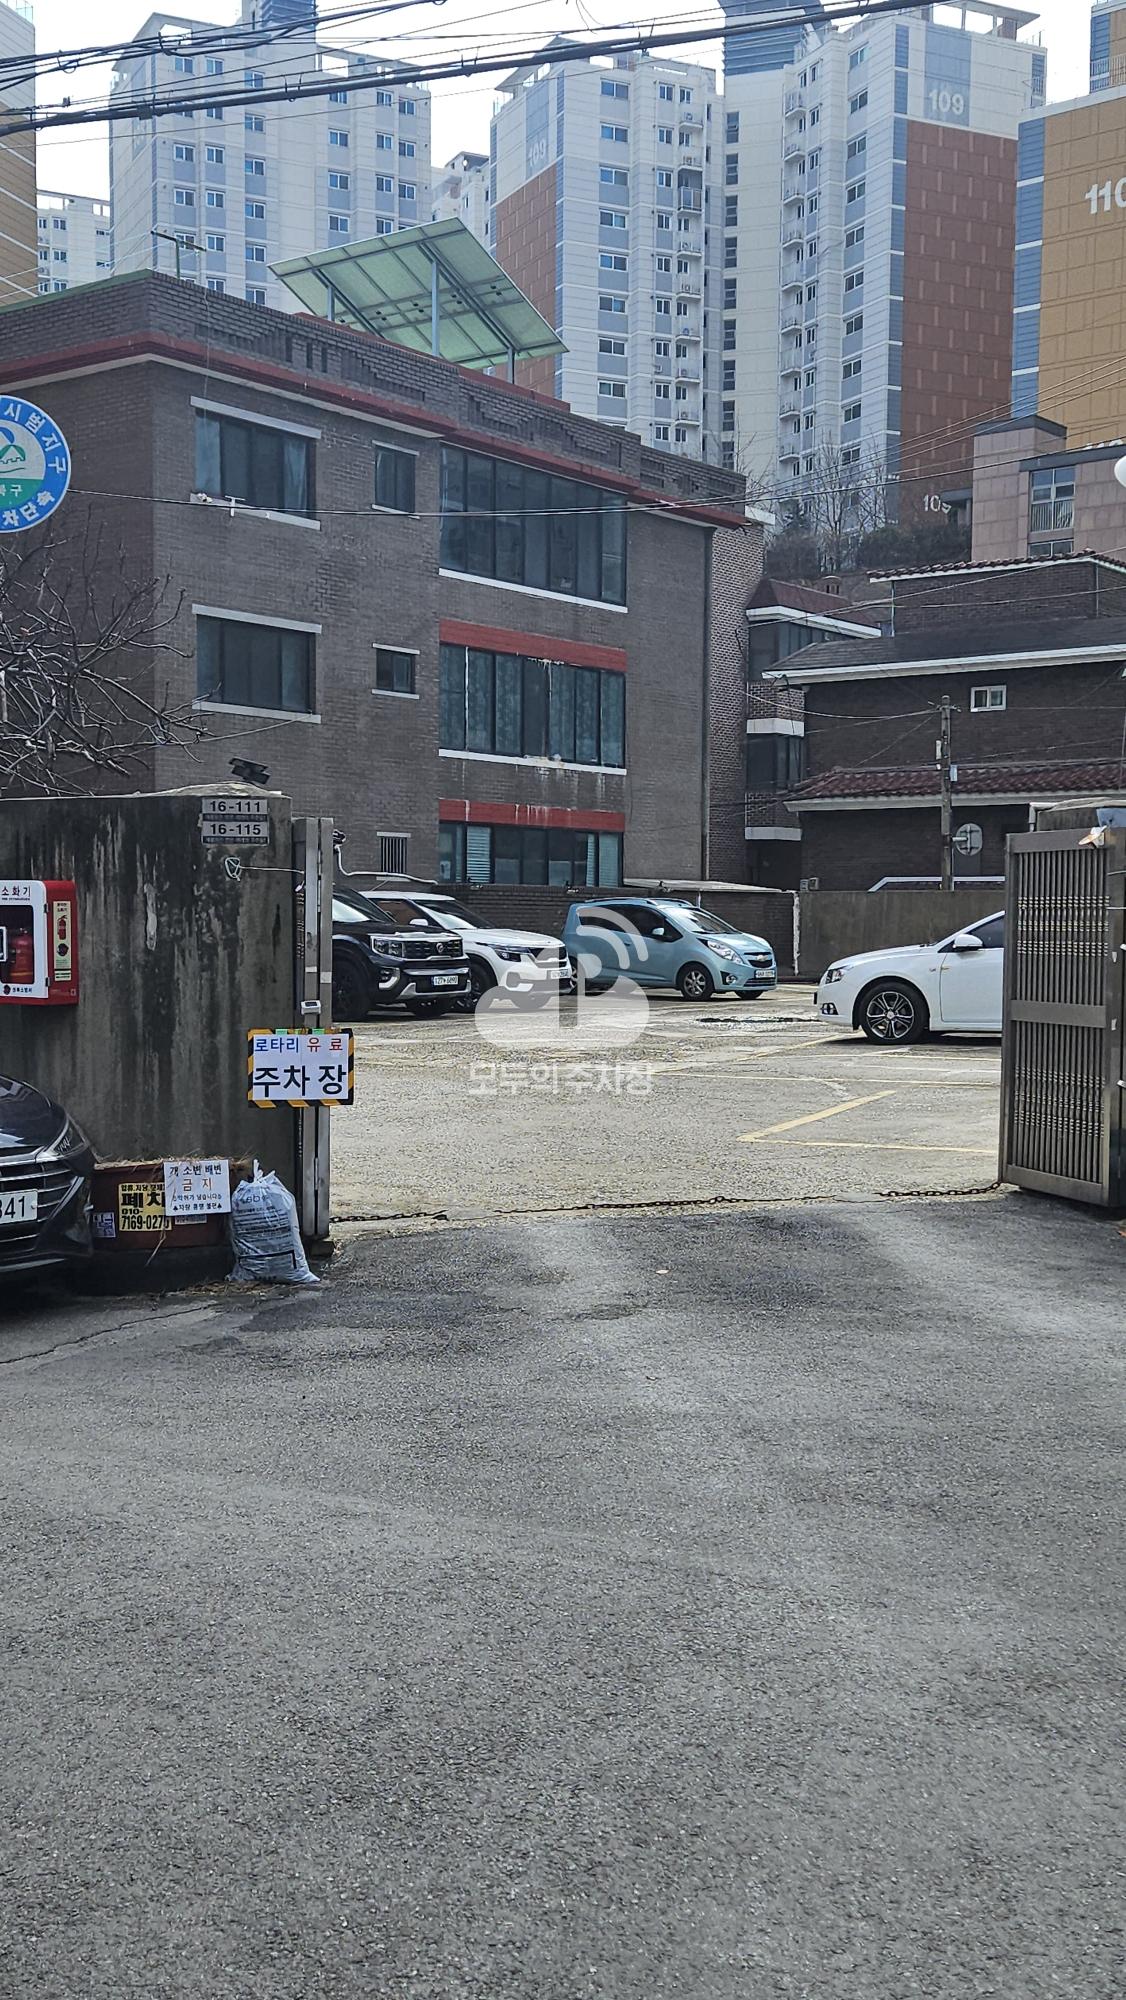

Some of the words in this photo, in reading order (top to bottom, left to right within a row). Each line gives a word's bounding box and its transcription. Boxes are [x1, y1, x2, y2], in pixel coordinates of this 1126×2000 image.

[929, 89, 964, 115] 109
[209, 800, 260, 813] 16-111
[209, 823, 261, 835] 16-115
[1, 886, 31, 897] 소화기
[254, 1037, 299, 1053] 로타리
[253, 1064, 347, 1098] 주차장
[0, 1195, 25, 1219] 41
